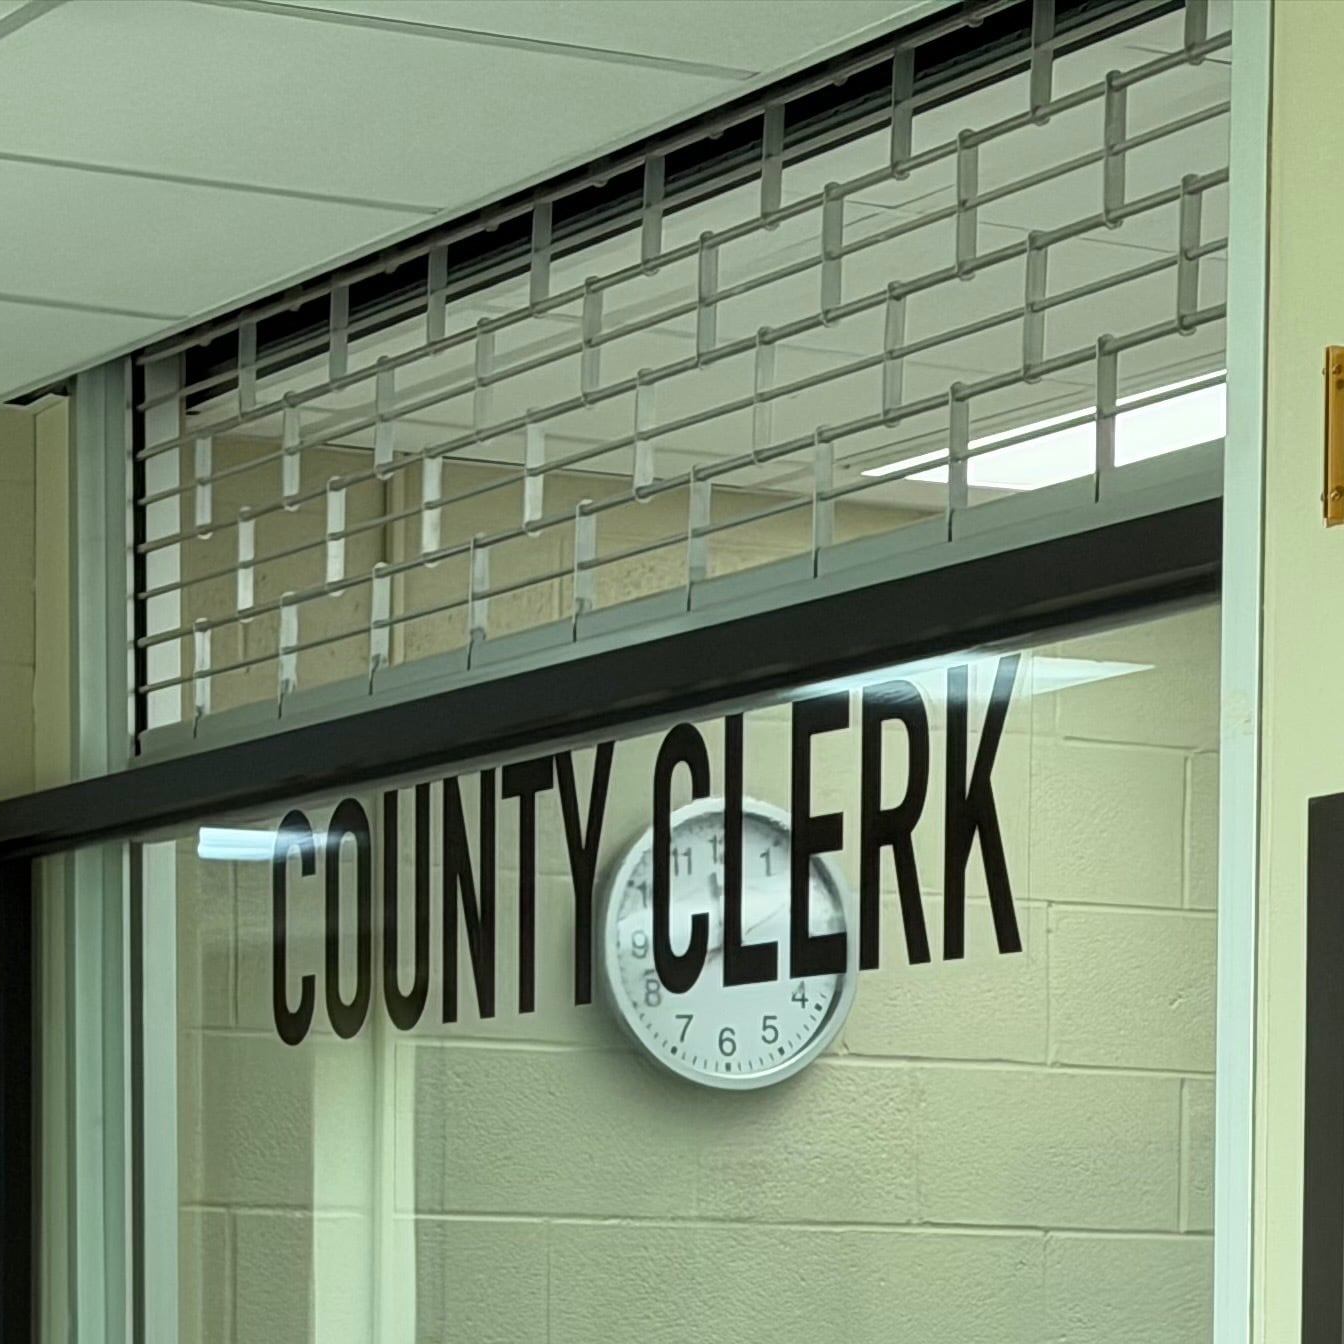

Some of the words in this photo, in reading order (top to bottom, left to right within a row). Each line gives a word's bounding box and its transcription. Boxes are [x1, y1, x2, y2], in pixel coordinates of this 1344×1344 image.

[273, 741, 614, 1045] COUNTY
[652, 653, 1023, 994] CLERK
[791, 980, 809, 1010] 4
[675, 1014, 693, 1043] 7
[761, 1015, 779, 1045] 5
[718, 1027, 737, 1057] 6
